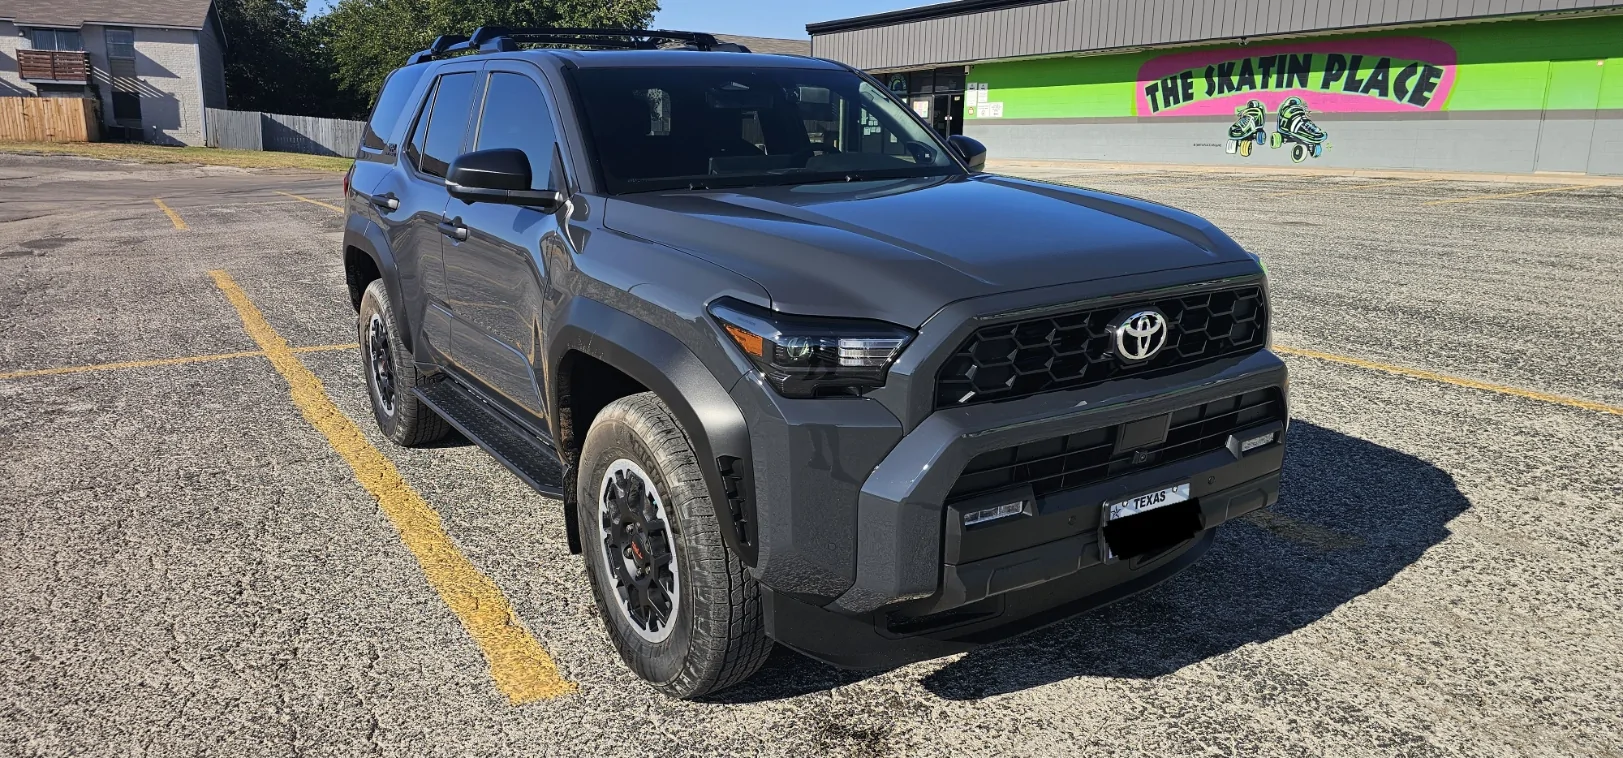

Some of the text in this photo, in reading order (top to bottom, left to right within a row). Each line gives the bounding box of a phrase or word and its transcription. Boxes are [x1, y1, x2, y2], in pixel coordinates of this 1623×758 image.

[1145, 53, 1444, 113] THE SKATIN PLACE
[1134, 491, 1166, 510] TEXAS
